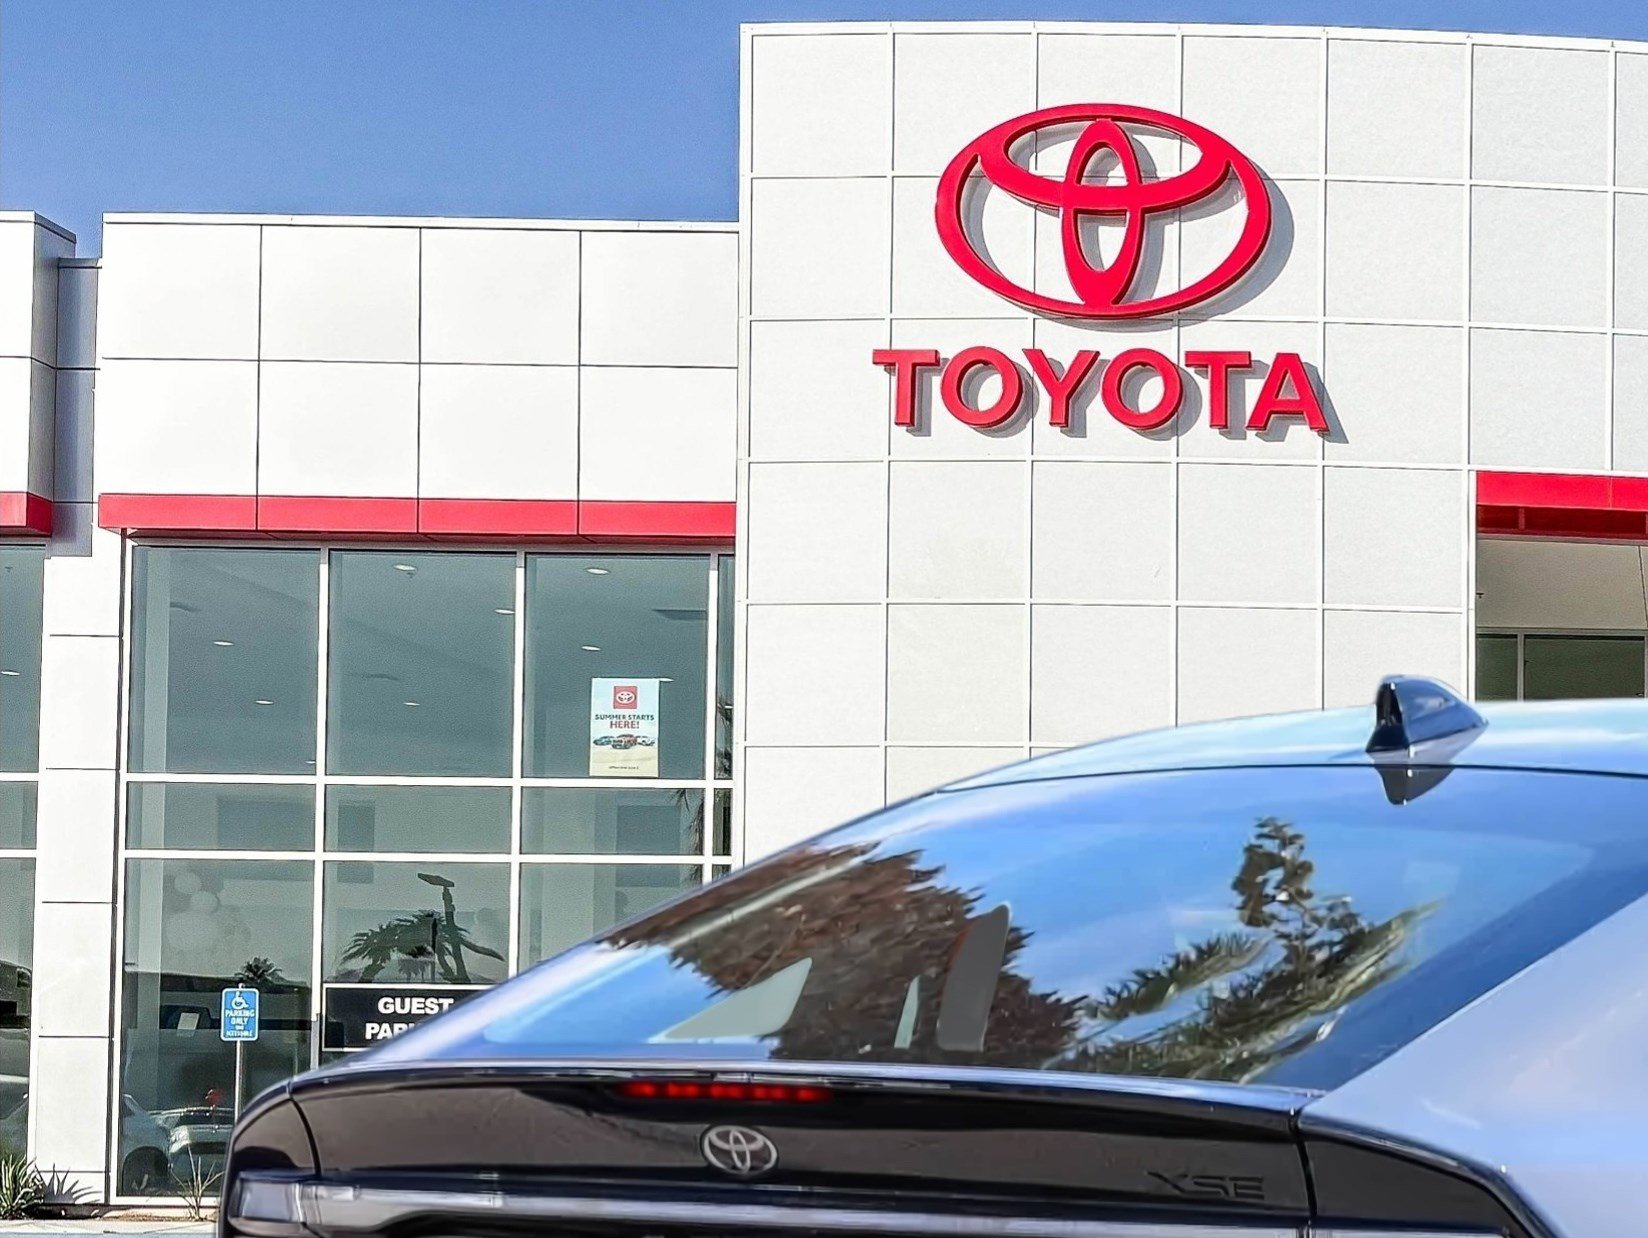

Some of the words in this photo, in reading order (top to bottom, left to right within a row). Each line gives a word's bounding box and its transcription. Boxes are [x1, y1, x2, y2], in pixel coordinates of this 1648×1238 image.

[872, 345, 1331, 435] TOYOTA
[594, 713, 627, 721] SUMMER
[609, 720, 640, 729] HERE!
[377, 996, 455, 1015] GUEST
